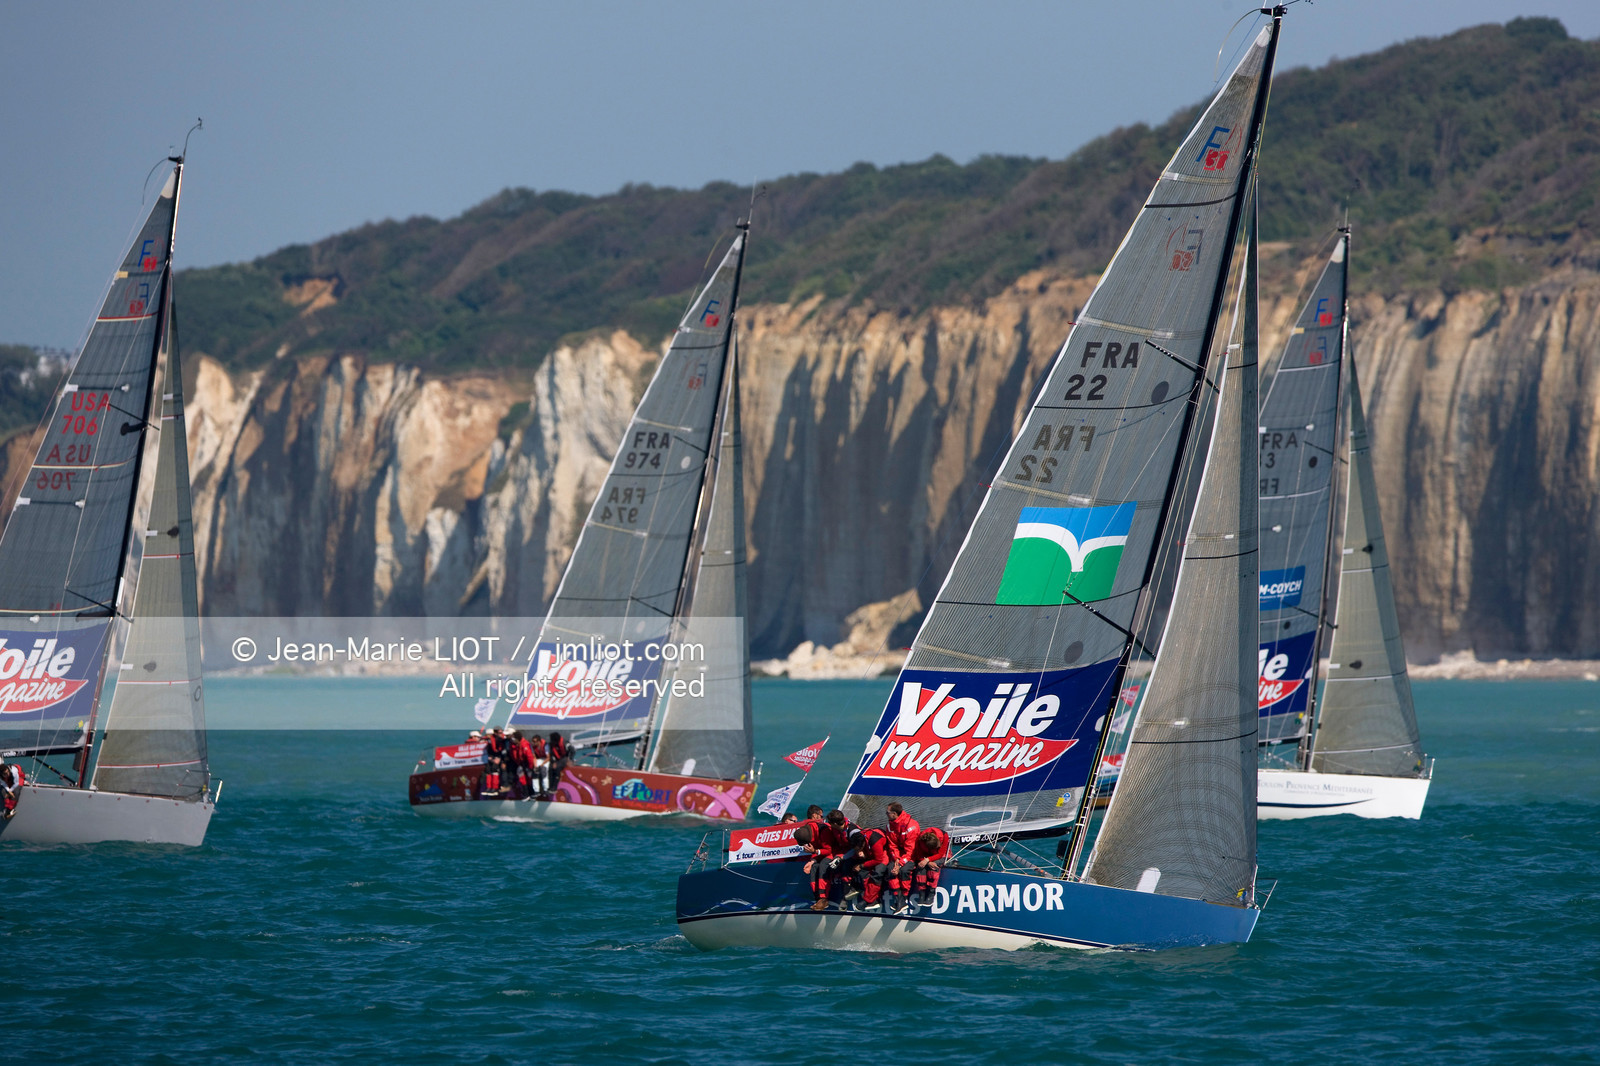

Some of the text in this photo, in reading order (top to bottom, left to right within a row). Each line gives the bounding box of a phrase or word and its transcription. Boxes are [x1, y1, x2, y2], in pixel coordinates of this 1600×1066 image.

[1080, 341, 1139, 369] FRA
[1064, 374, 1108, 401] 22
[71, 391, 111, 412] USA
[62, 414, 98, 436] 706
[633, 431, 670, 449] FRA
[1260, 432, 1299, 450] FRA
[624, 452, 661, 469] 974
[0, 638, 77, 681] oile
[533, 649, 634, 689] Voile
[1259, 648, 1289, 682] le
[0, 678, 67, 714] gazine
[896, 682, 1061, 739] Voile
[879, 736, 1045, 788] magazine
[632, 782, 673, 804] PORT
[1286, 780, 1320, 791] PROVENCE
[755, 829, 781, 844] CÔTES
[742, 852, 756, 860] tour
[761, 848, 781, 857] france
[788, 845, 803, 854] voile
[930, 882, 1065, 915] D'ARMOR
